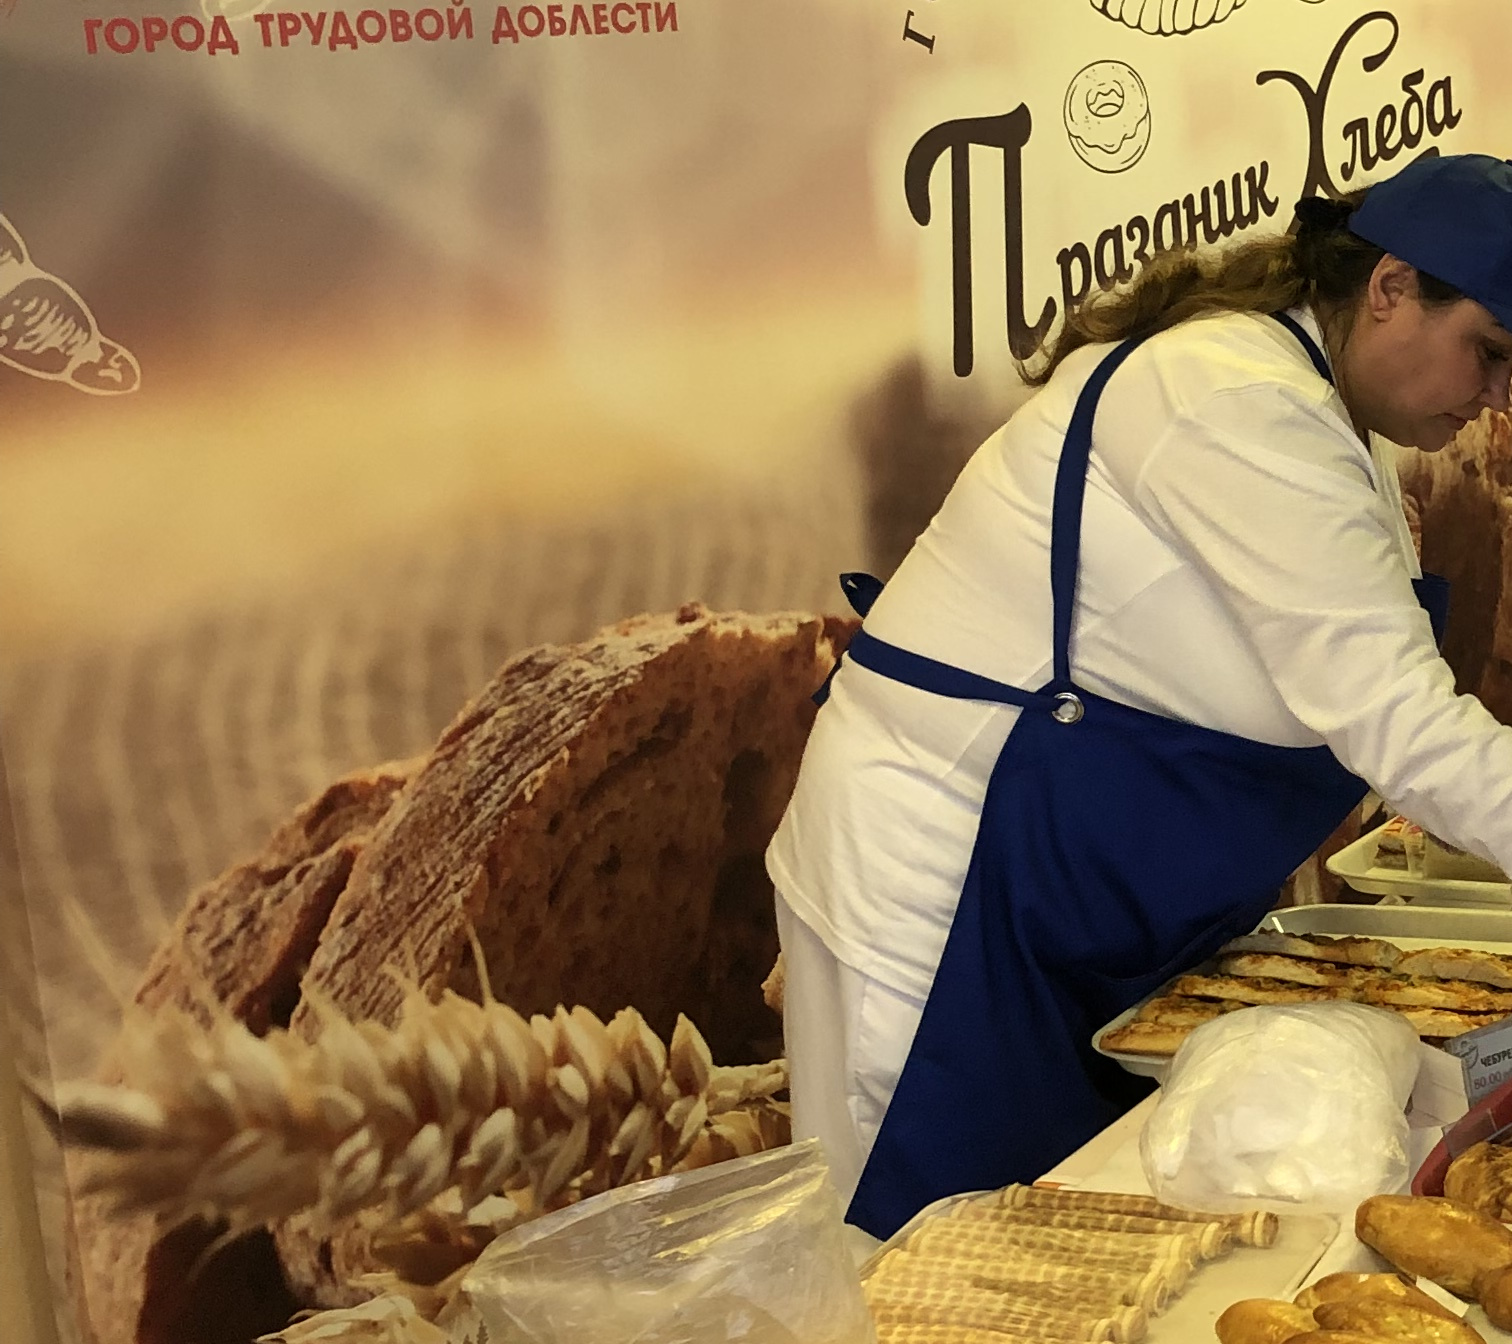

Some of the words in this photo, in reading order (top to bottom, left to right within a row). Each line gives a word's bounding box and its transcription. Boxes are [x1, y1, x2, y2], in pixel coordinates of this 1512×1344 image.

[83, 16, 239, 55] ГОРОД
[254, 0, 474, 51] ТРУДОВОЙ
[491, 1, 679, 44] ДОБЛЕСТИ
[1256, 10, 1462, 236] Хлеба
